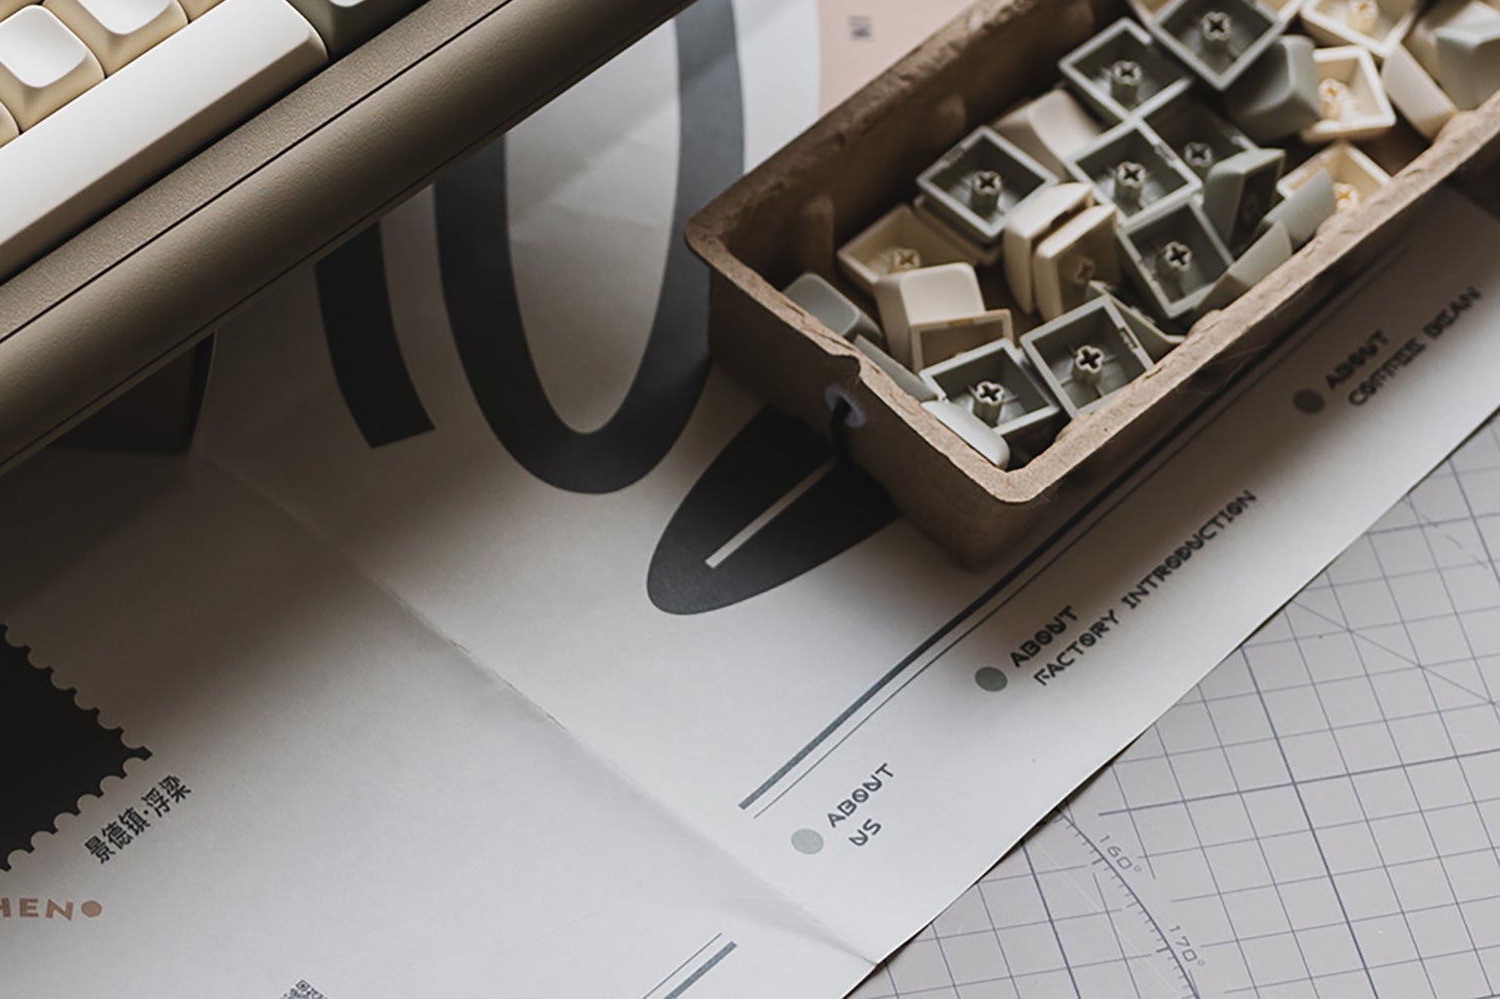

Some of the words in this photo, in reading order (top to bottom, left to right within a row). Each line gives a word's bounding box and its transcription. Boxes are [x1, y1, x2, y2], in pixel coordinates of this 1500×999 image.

[1326, 329, 1388, 391] ABOUT
[1349, 336, 1426, 406] COFFEE
[1423, 285, 1482, 339] BEAN
[1034, 609, 1119, 686] FACTORY
[1120, 489, 1257, 609] INTRODUCTION
[1010, 605, 1078, 668] ABOUT
[827, 762, 894, 828] ABOUT
[848, 818, 882, 847] US
